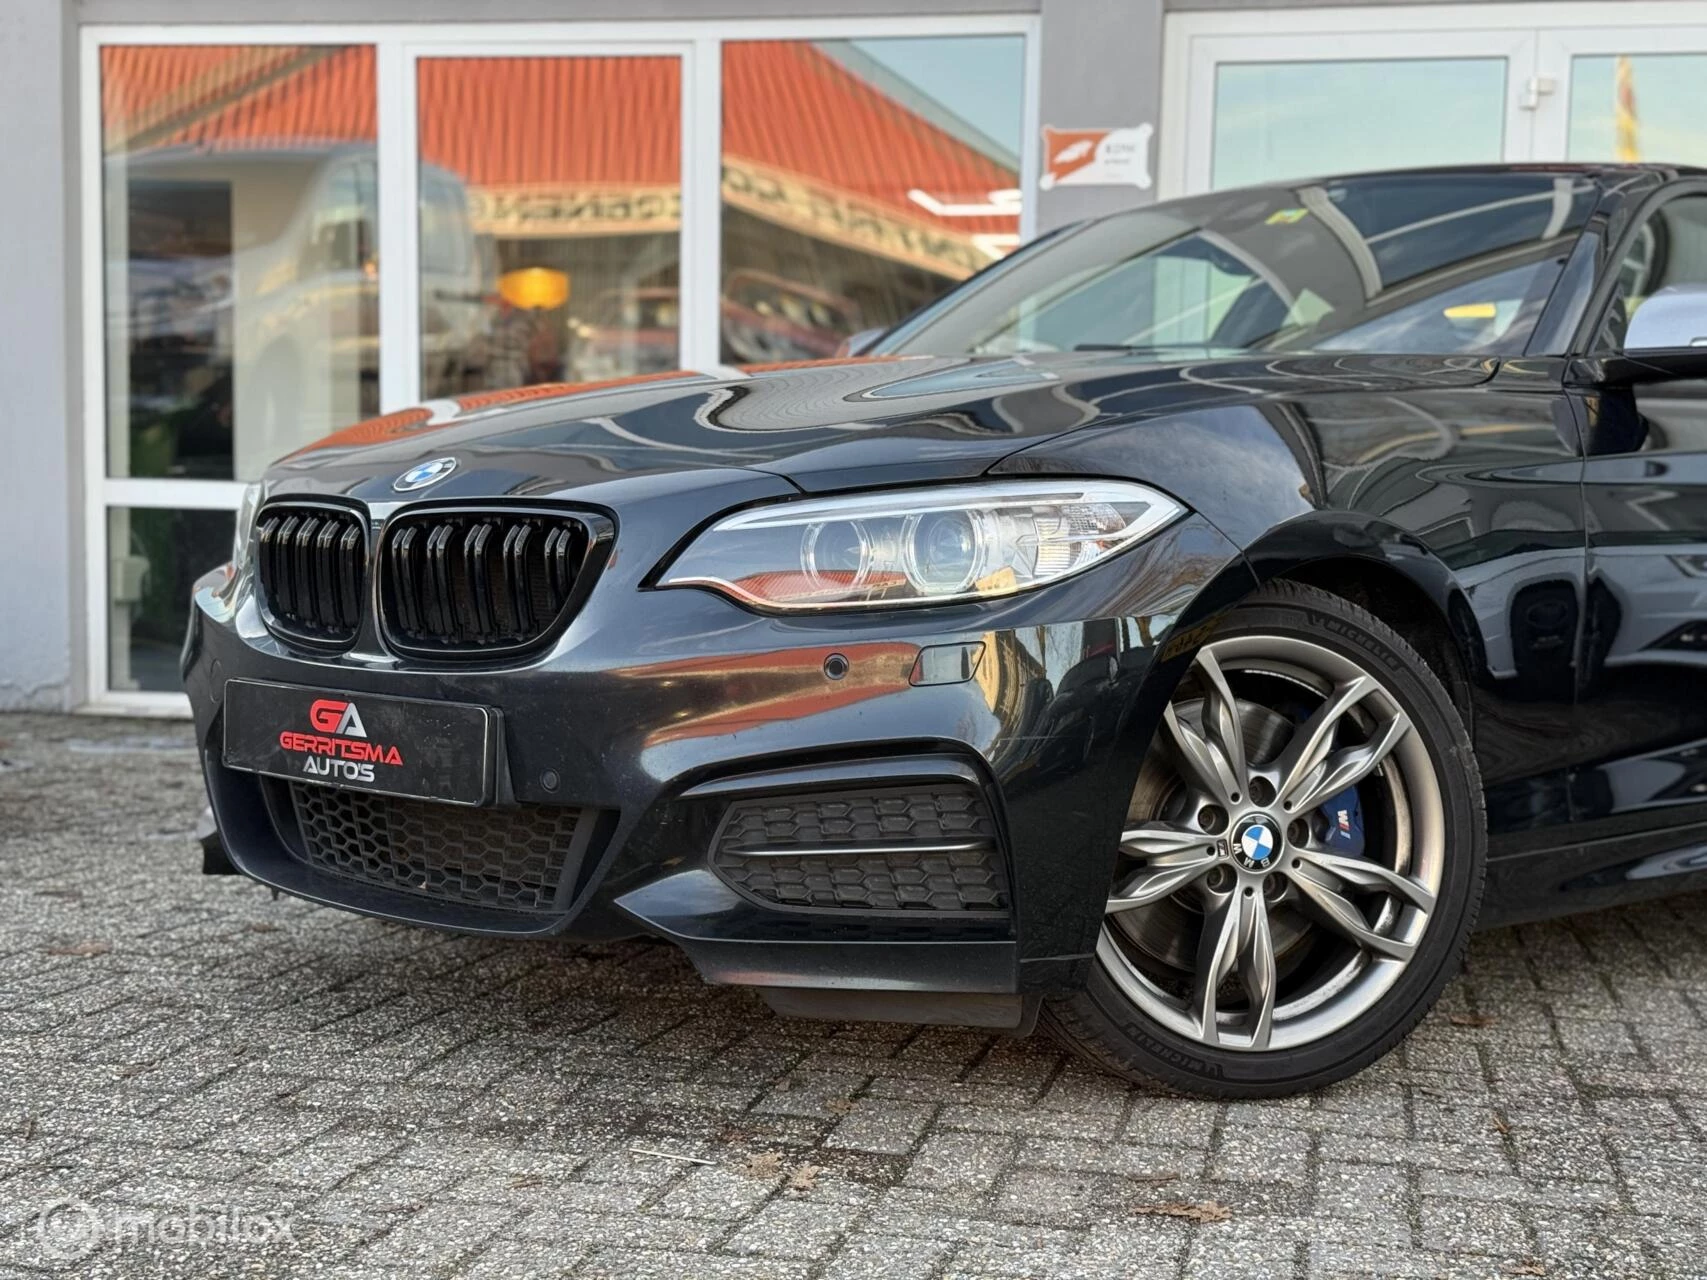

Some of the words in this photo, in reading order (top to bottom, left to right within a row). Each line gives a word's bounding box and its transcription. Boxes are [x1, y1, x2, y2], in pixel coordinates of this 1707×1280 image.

[1327, 620, 1399, 668] MICHELIN
[310, 699, 367, 738] GA
[280, 731, 403, 766] GERRITSMA
[303, 755, 375, 783] AUTO'S
[1233, 843, 1270, 868] BMW
